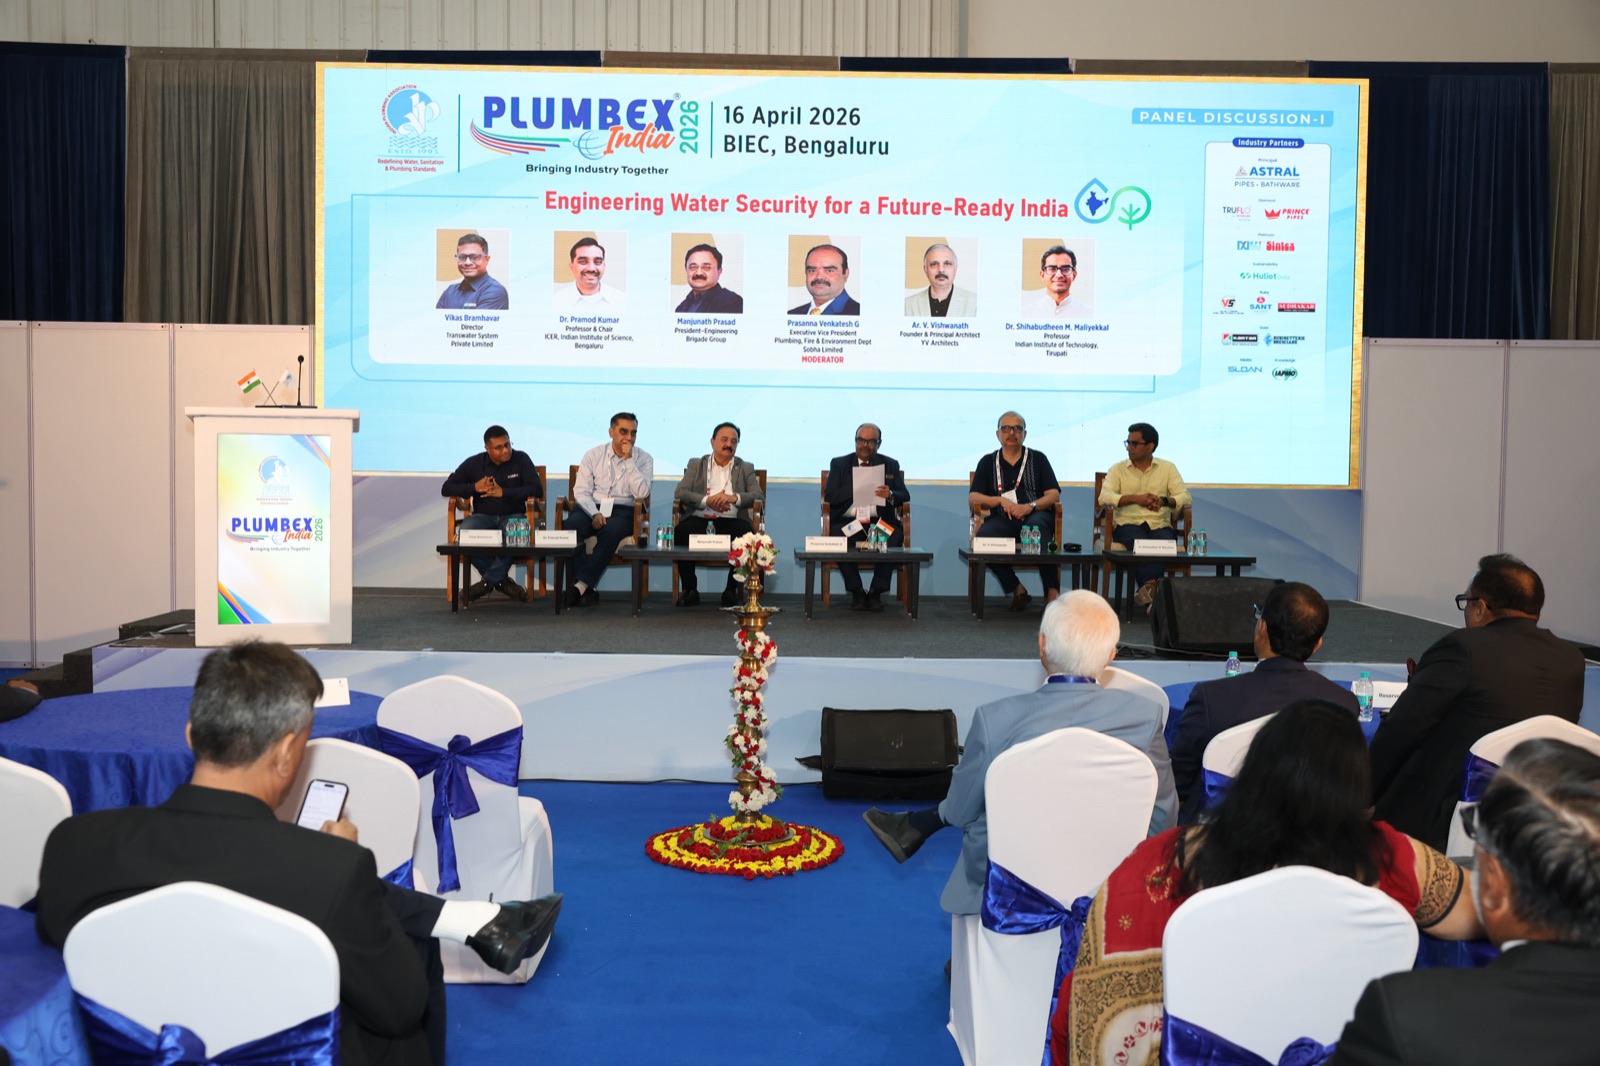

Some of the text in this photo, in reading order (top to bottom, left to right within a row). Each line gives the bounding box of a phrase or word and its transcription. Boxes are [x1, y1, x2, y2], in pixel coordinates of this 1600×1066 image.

[484, 96, 674, 131] PLUMBEX
[724, 106, 861, 127] 16 April 2026
[1140, 112, 1324, 124] PANEL DISCUSSION-I
[680, 100, 698, 153] 2026
[604, 123, 675, 155] India
[724, 135, 889, 157] BIEC, Bengaluru
[1238, 139, 1267, 147] Industry
[526, 164, 668, 176] Bringing Industry Together
[1250, 166, 1299, 176] ASTRAL
[546, 190, 1068, 221] Engineering Water Security for a Future-Ready India
[1267, 241, 1295, 251] Sintex
[232, 518, 313, 532] PLUMBEX
[315, 518, 323, 541] 2026
[283, 529, 313, 543] India
